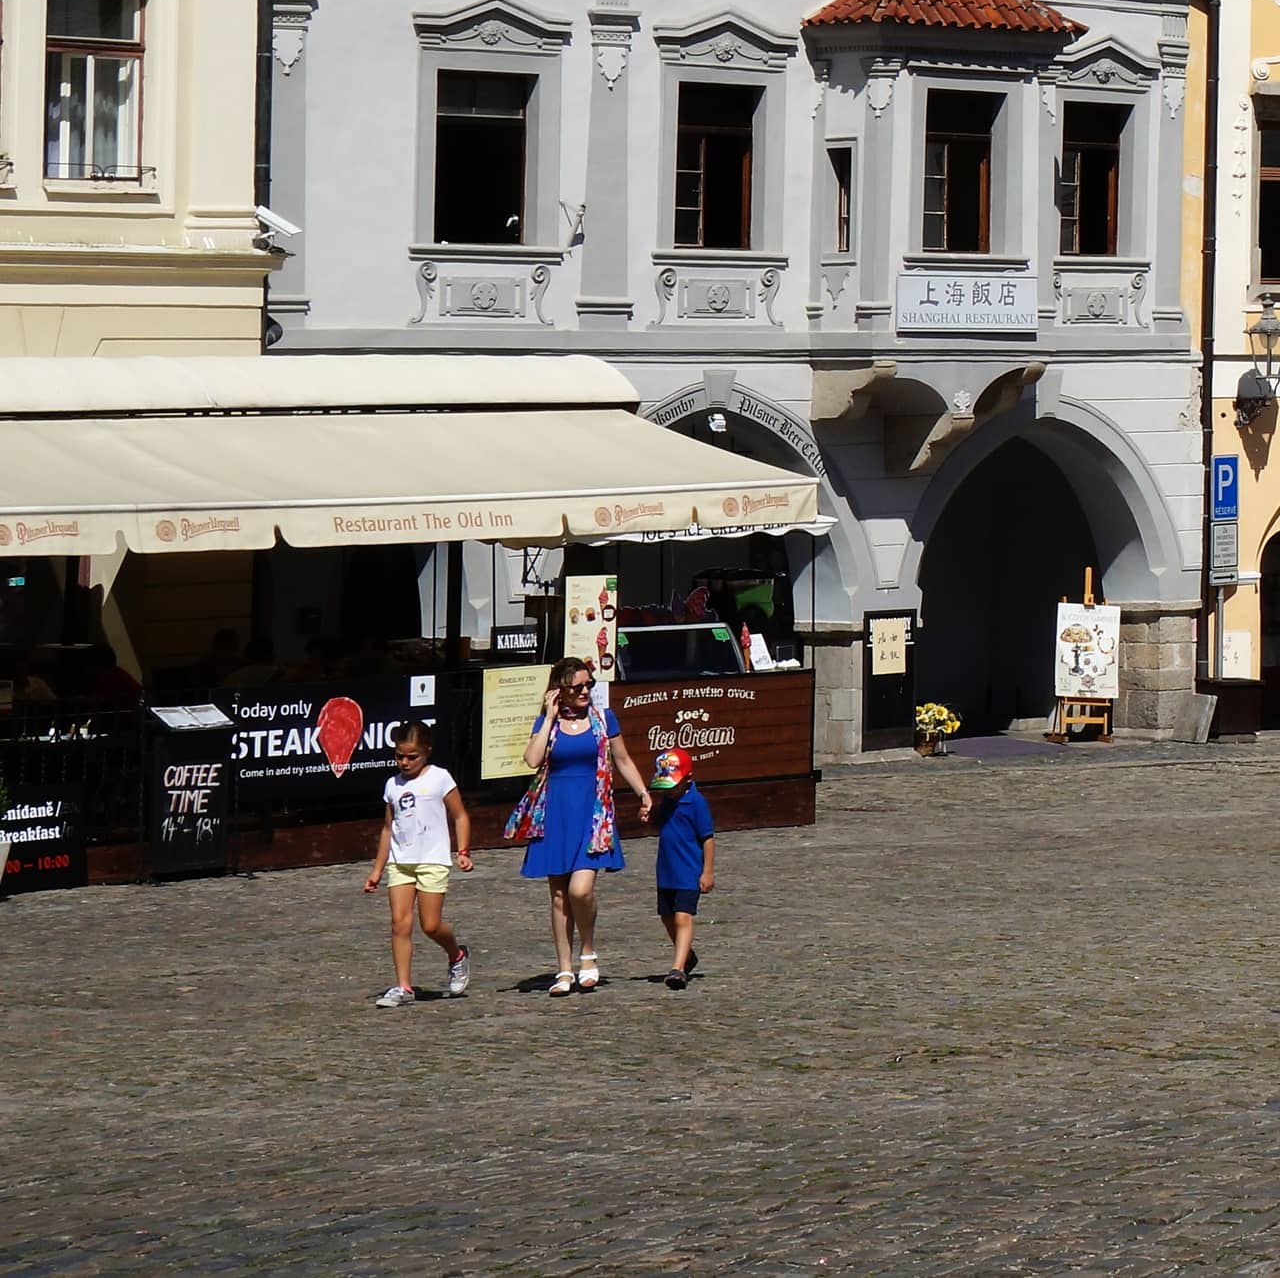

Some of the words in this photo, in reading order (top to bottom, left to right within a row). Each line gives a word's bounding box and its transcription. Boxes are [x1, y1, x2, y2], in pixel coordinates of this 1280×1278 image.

[919, 280, 1017, 306] 上海飯店
[902, 313, 961, 323] SHANGHAI
[965, 313, 1036, 324] RESTAURANT
[737, 395, 779, 428] Pilsner
[778, 418, 803, 447] Beer
[1218, 464, 1234, 502] P
[333, 515, 418, 533] Restaurant
[421, 512, 451, 531] The
[457, 510, 483, 529] Old
[488, 510, 514, 527] Inn
[280, 699, 313, 719] only
[623, 691, 669, 709] ZMRZLINA
[672, 689, 679, 700] Z
[682, 685, 724, 699] PRAVÉHO
[727, 689, 757, 701] OVOCE
[675, 708, 710, 724] Joe's
[231, 726, 321, 760] STEAK
[648, 724, 675, 751] Ice
[677, 723, 736, 749] Cream
[163, 763, 223, 787] COFFEE
[240, 767, 264, 778] Come
[266, 766, 274, 777] in
[275, 765, 291, 776] and
[292, 764, 304, 776] try
[305, 762, 330, 774] steaks
[352, 759, 386, 772] premium
[167, 789, 212, 815] TIME
[38, 854, 70, 871] 10:00
